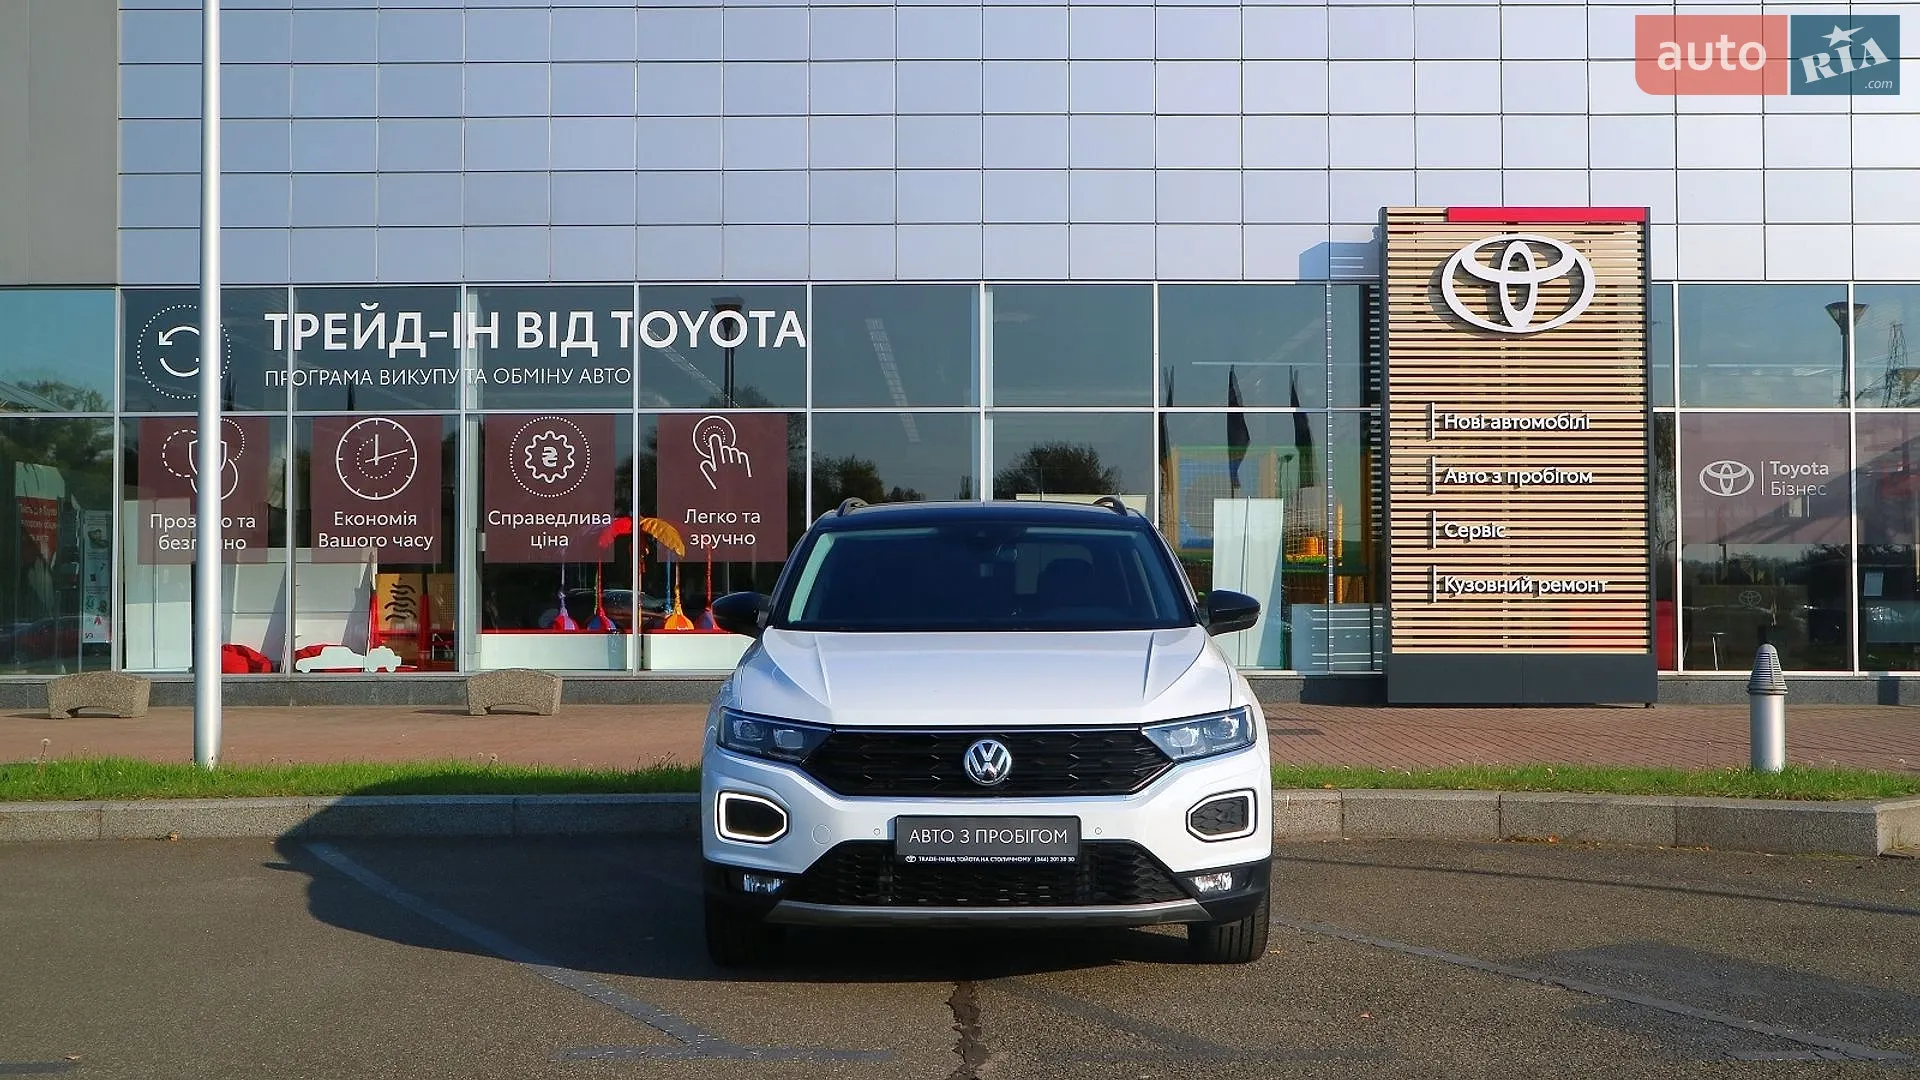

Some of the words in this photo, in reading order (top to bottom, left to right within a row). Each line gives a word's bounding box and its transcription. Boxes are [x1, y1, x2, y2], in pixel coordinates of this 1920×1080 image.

[264, 302, 499, 359] ТРЕЙД-ІН
[517, 310, 599, 358] ВІД
[610, 309, 807, 349] TOYOTA
[265, 369, 374, 387] ПРОГРАМА
[379, 368, 460, 386] ВИКУПУ
[464, 367, 488, 385] ТА
[493, 367, 575, 385] ОБМІНУ
[578, 367, 632, 385] АВТО
[1443, 413, 1487, 430] Нові
[1490, 412, 1591, 430] автомобілі
[1443, 468, 1488, 484] Авто
[1491, 471, 1502, 484] з
[1507, 466, 1593, 487] пробігом
[1769, 460, 1830, 479] Toyota
[1770, 480, 1827, 497] Бізнес
[150, 513, 232, 533] Прозо
[236, 517, 257, 528] та
[333, 510, 418, 526] Економія
[488, 510, 611, 527] Справедлива
[684, 508, 736, 526] Легко
[741, 512, 761, 525] та
[689, 532, 756, 548] зручно
[1443, 521, 1507, 541] Сервіс
[318, 533, 388, 548] Вашого
[392, 535, 434, 551] часу
[530, 533, 570, 549] ціна
[1443, 575, 1534, 596] Кузовний
[1539, 578, 1609, 596] ремонт
[908, 829, 955, 844] АВТО
[975, 828, 1069, 845] ПРОБІГОМ
